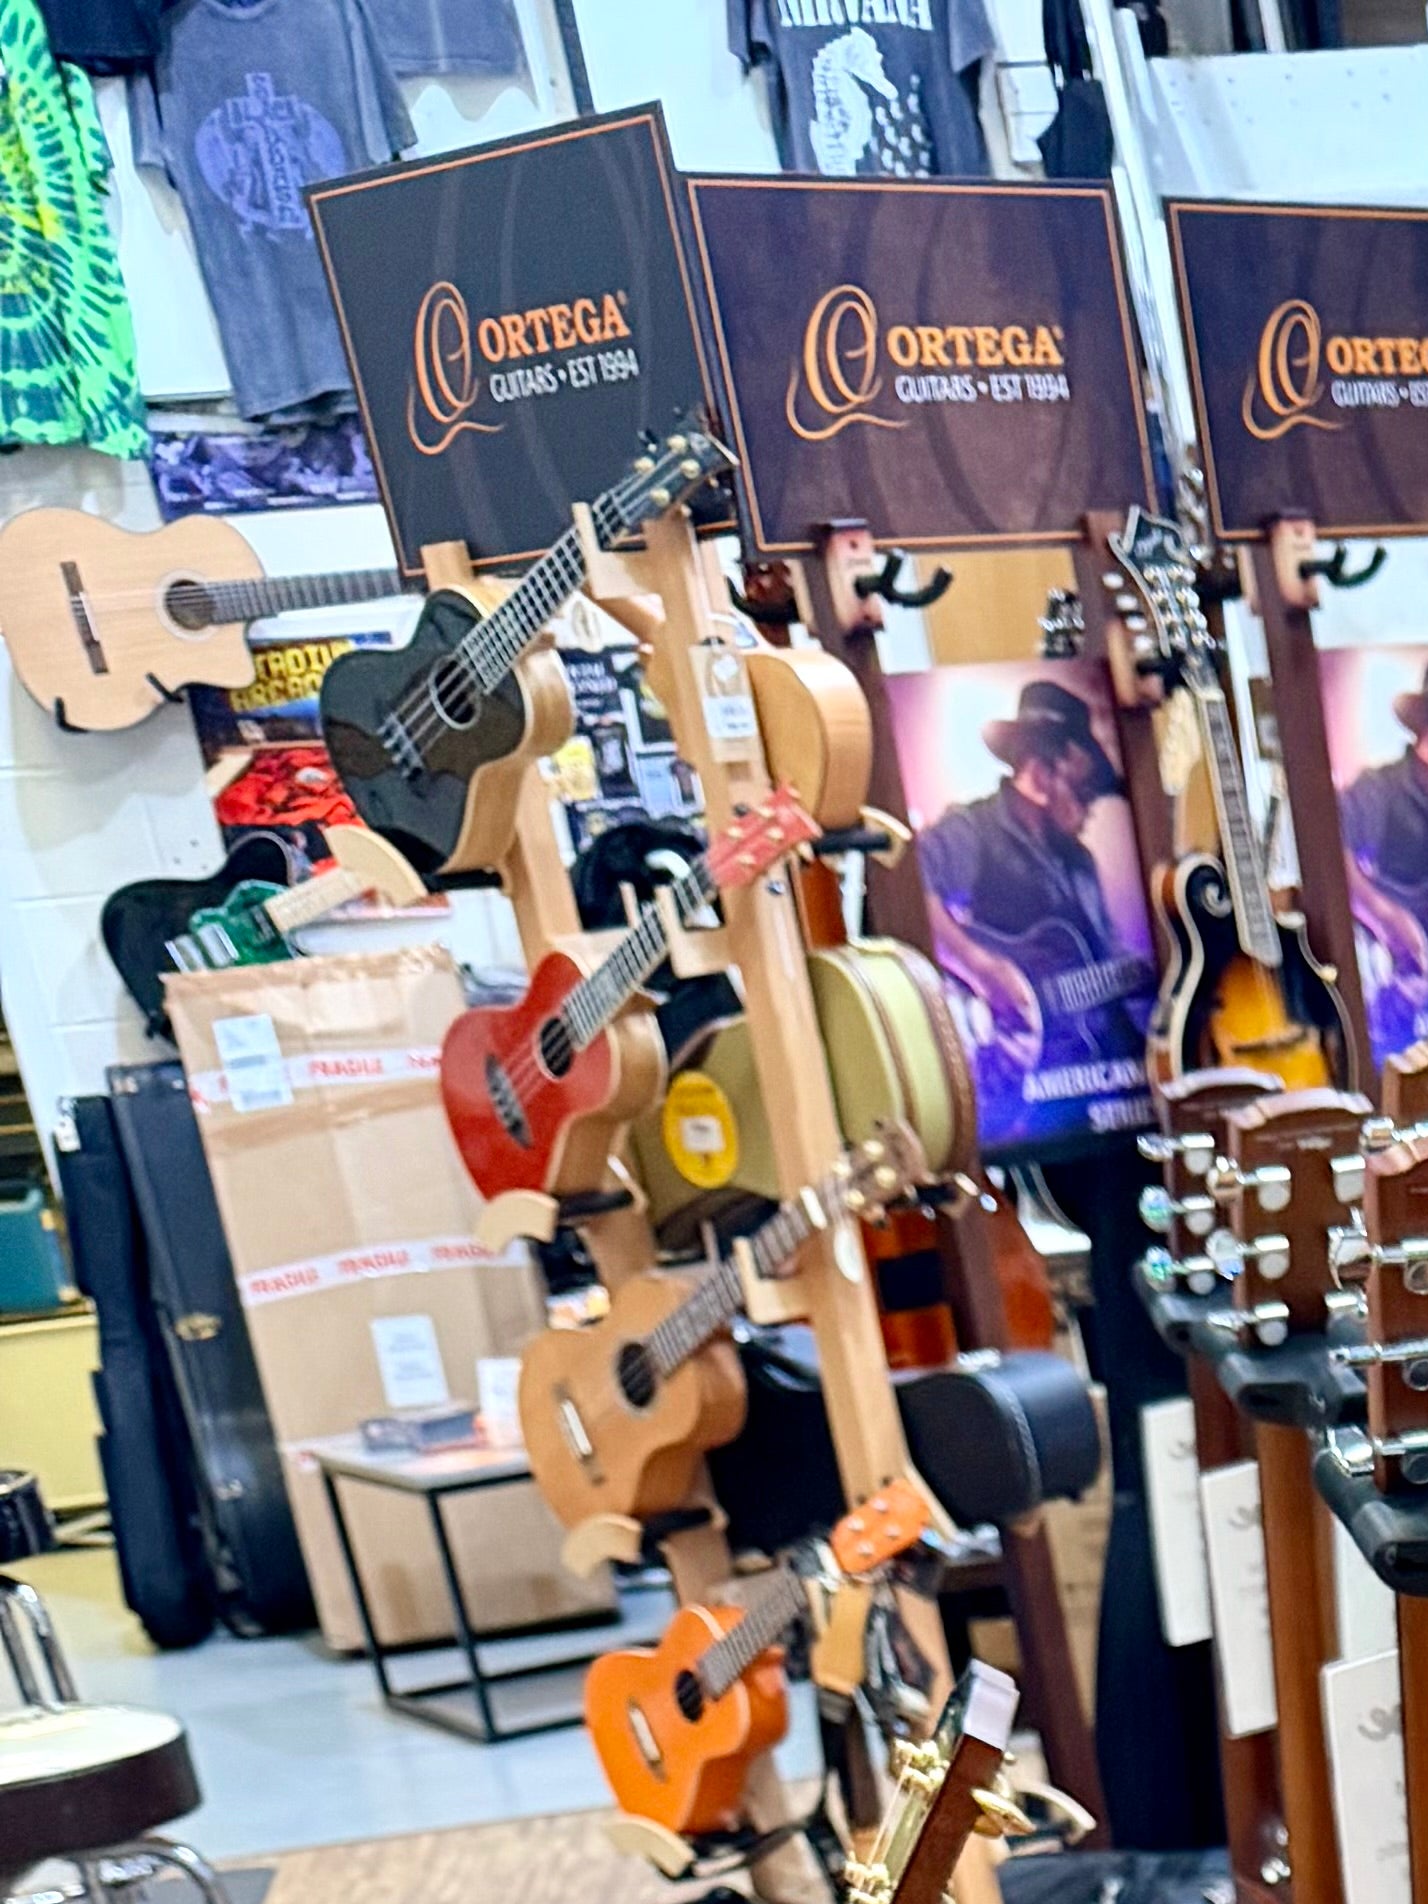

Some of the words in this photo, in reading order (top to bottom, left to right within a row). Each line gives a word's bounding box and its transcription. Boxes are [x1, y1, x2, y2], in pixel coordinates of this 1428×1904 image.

[478, 294, 631, 362] ORTEGA
[887, 325, 1064, 367] ORTEGA
[489, 363, 558, 402] GUITARS
[567, 355, 598, 388] EST
[895, 374, 977, 403] GUITARS
[989, 374, 1022, 402] EST
[1331, 379, 1400, 408] GUITARS
